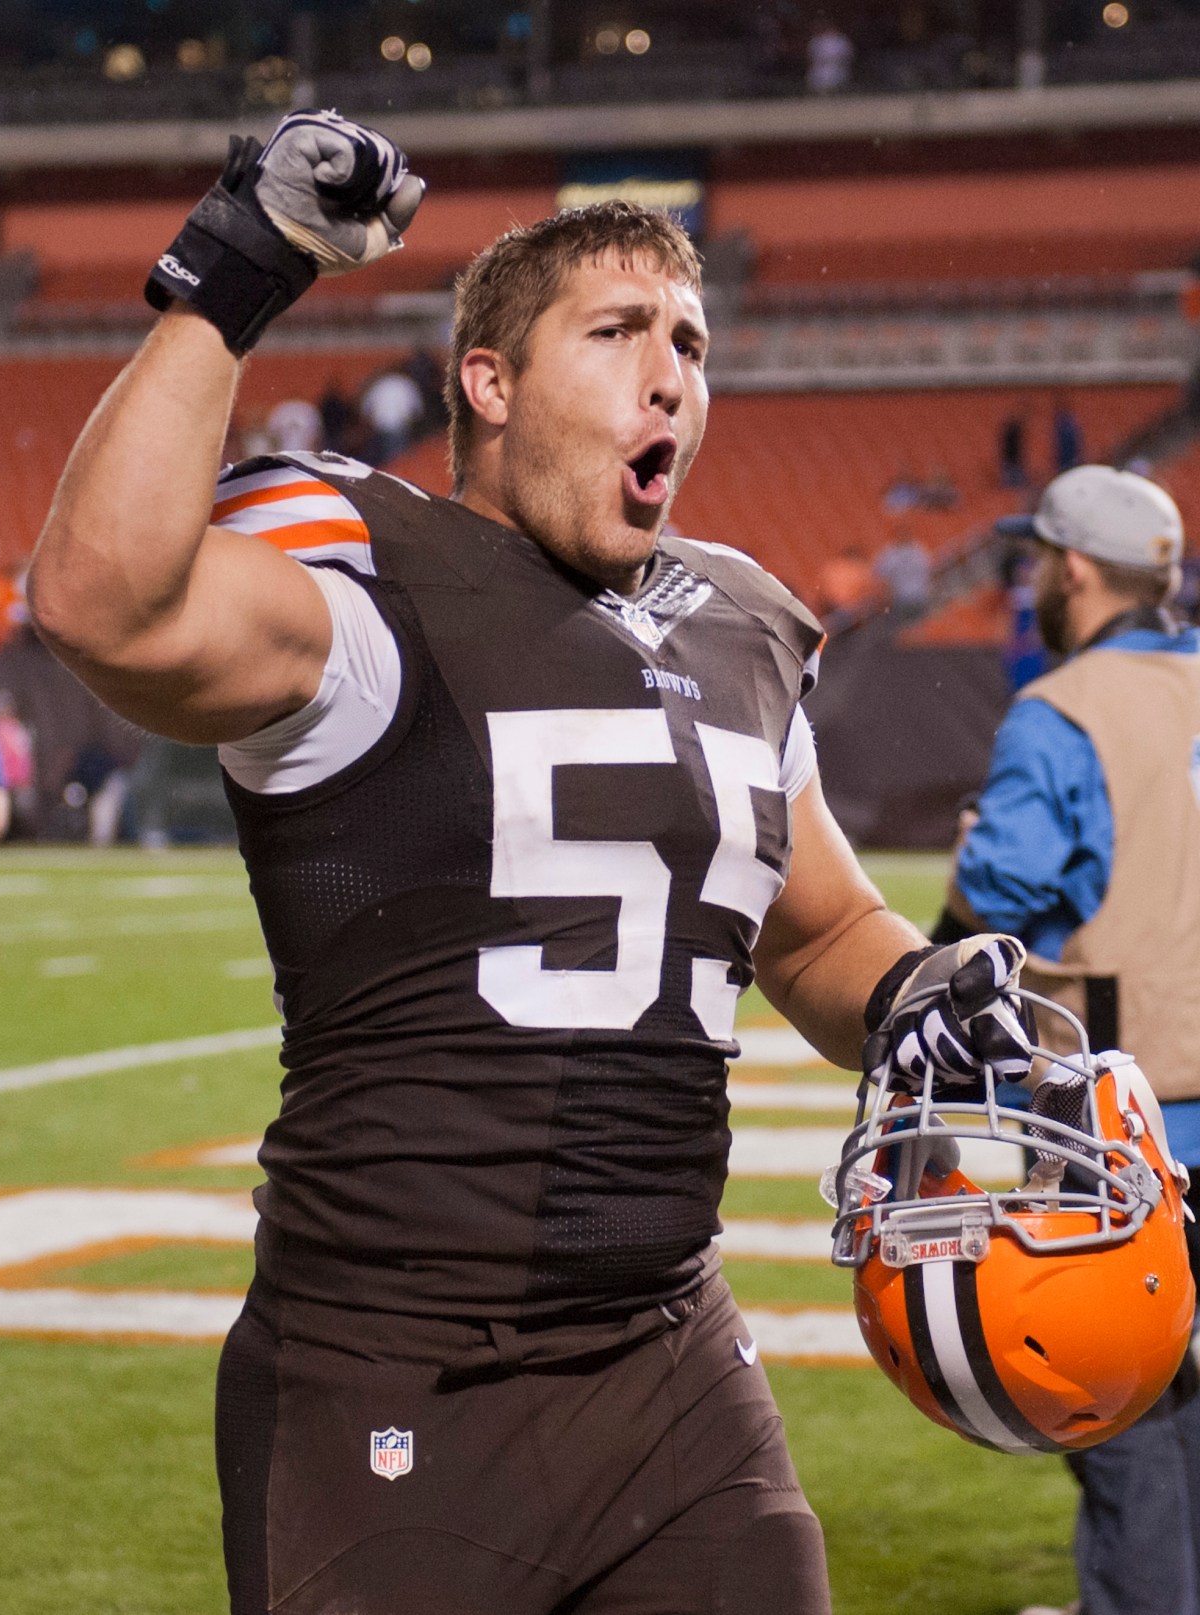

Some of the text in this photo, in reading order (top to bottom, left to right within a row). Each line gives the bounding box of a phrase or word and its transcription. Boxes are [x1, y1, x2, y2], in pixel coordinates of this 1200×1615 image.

[641, 669, 701, 701] BROWNS
[478, 708, 786, 1042] 55
[377, 1451, 406, 1471] NFL
